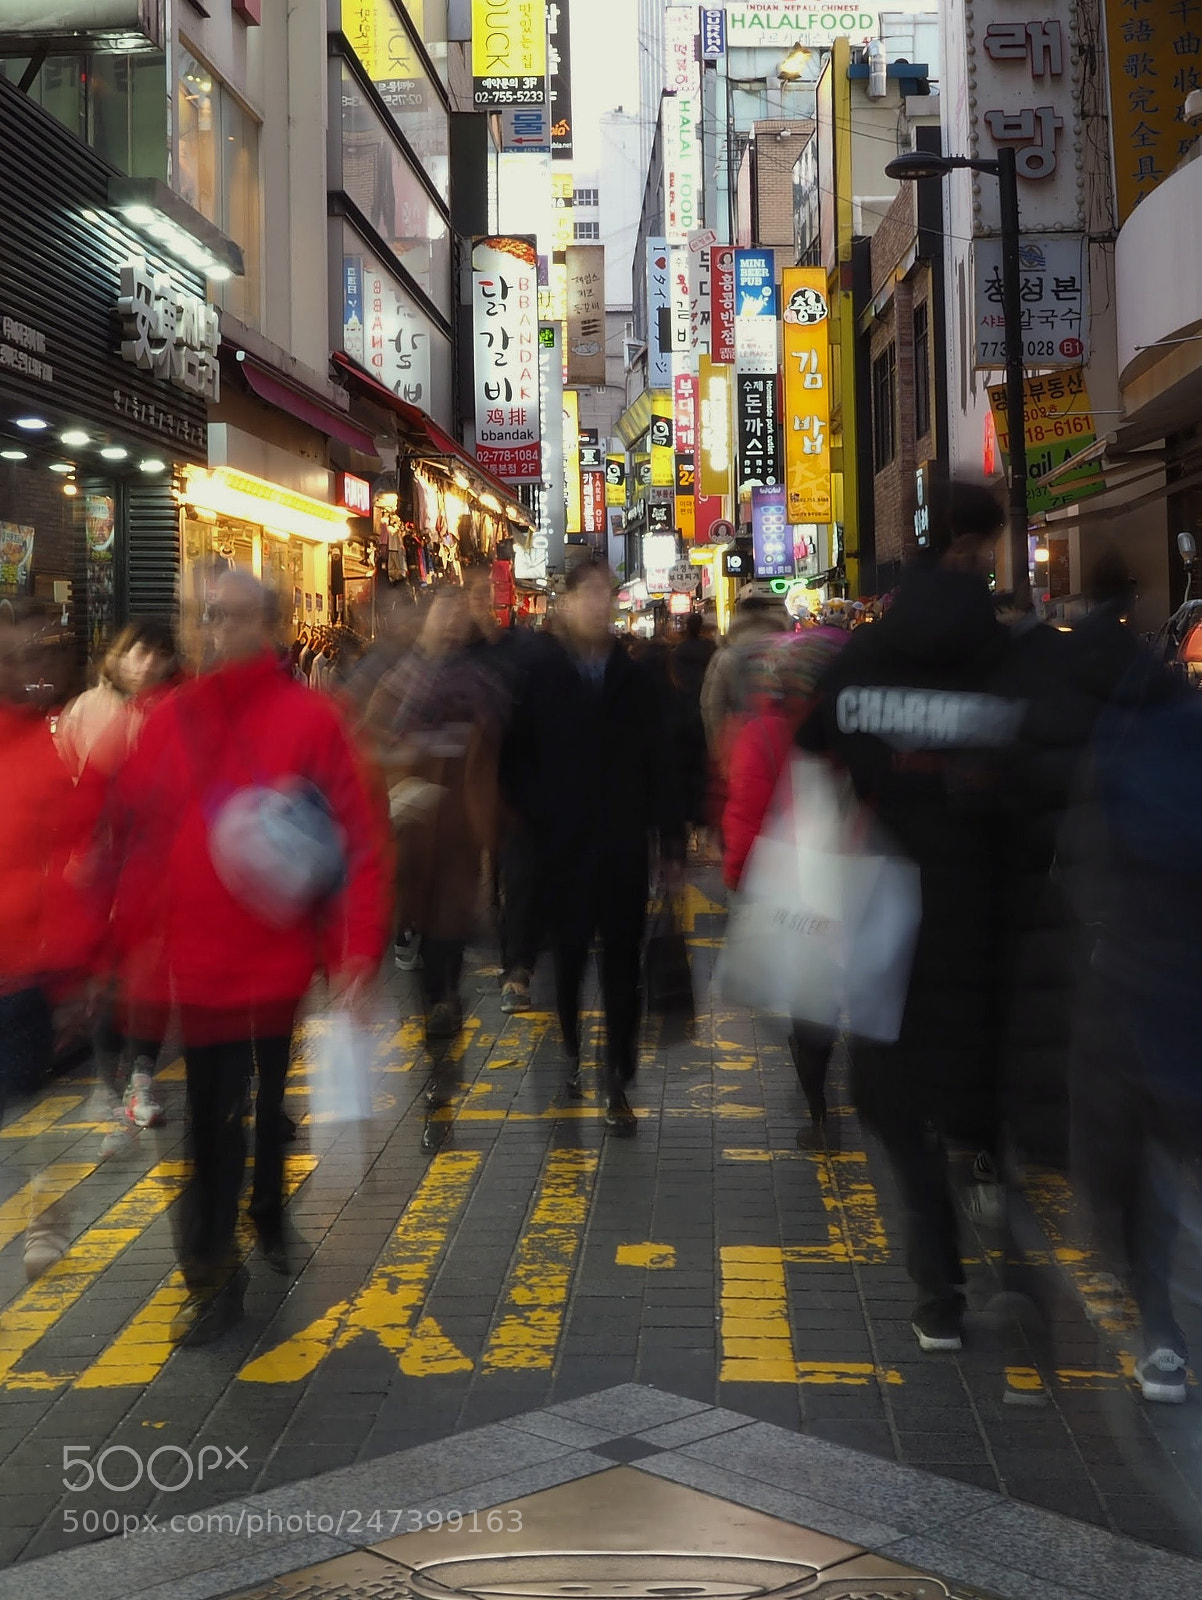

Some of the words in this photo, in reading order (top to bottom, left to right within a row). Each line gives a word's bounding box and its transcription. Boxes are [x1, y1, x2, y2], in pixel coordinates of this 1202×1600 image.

[706, 10, 721, 53] GURKHA
[522, 77, 538, 89] 3F
[474, 90, 544, 103] 02-755-5233
[680, 173, 693, 228] FOOD
[739, 258, 766, 268] MINI
[740, 268, 770, 277] BEER
[740, 277, 763, 286] PUB
[477, 275, 514, 403] 닭갈비
[518, 277, 532, 400] BBANDAK
[1063, 344, 1080, 354] B1
[743, 380, 764, 391] 수제
[991, 371, 1083, 411] 명부동산
[765, 380, 774, 418] Homemade
[792, 348, 828, 456] 김밥
[486, 409, 527, 427] 鸡排
[744, 394, 764, 456] 돈까스
[765, 418, 775, 434] pork
[481, 429, 534, 442] bbandak
[766, 434, 775, 455] cutlet
[476, 450, 539, 463] 02-778-1084
[522, 463, 535, 474] 2F
[726, 555, 742, 568] 10
